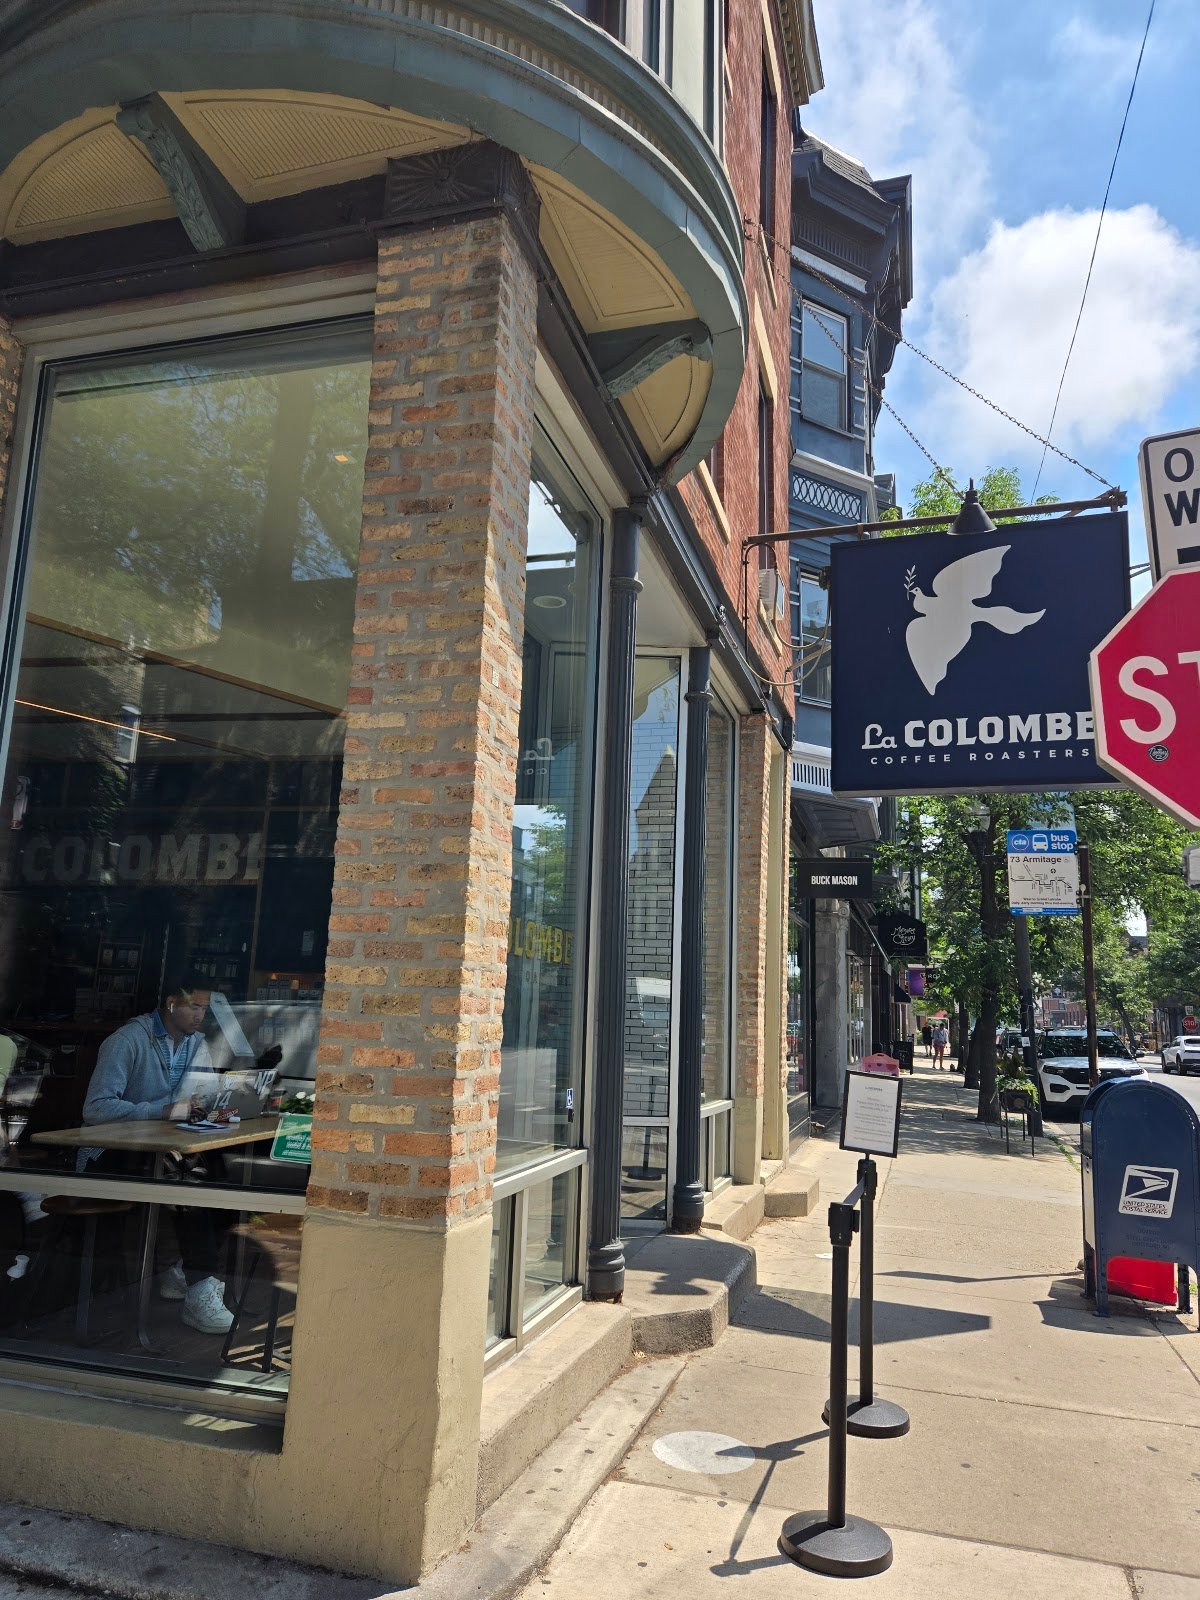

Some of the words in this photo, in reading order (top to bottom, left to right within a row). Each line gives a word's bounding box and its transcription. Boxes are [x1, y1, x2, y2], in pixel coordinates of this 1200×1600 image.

[861, 723, 898, 750] La
[904, 711, 1095, 748] COLOMBE
[870, 753, 952, 765] COFFEE
[969, 748, 1090, 761] ROASTERS
[1050, 833, 1070, 842] bus
[1051, 842, 1074, 852] stop
[1023, 855, 1062, 865] Armitage
[811, 875, 830, 885] BUCK
[831, 875, 858, 886] MASON
[508, 916, 574, 965] LOMBE
[1144, 1207, 1168, 1215] SERVICE
